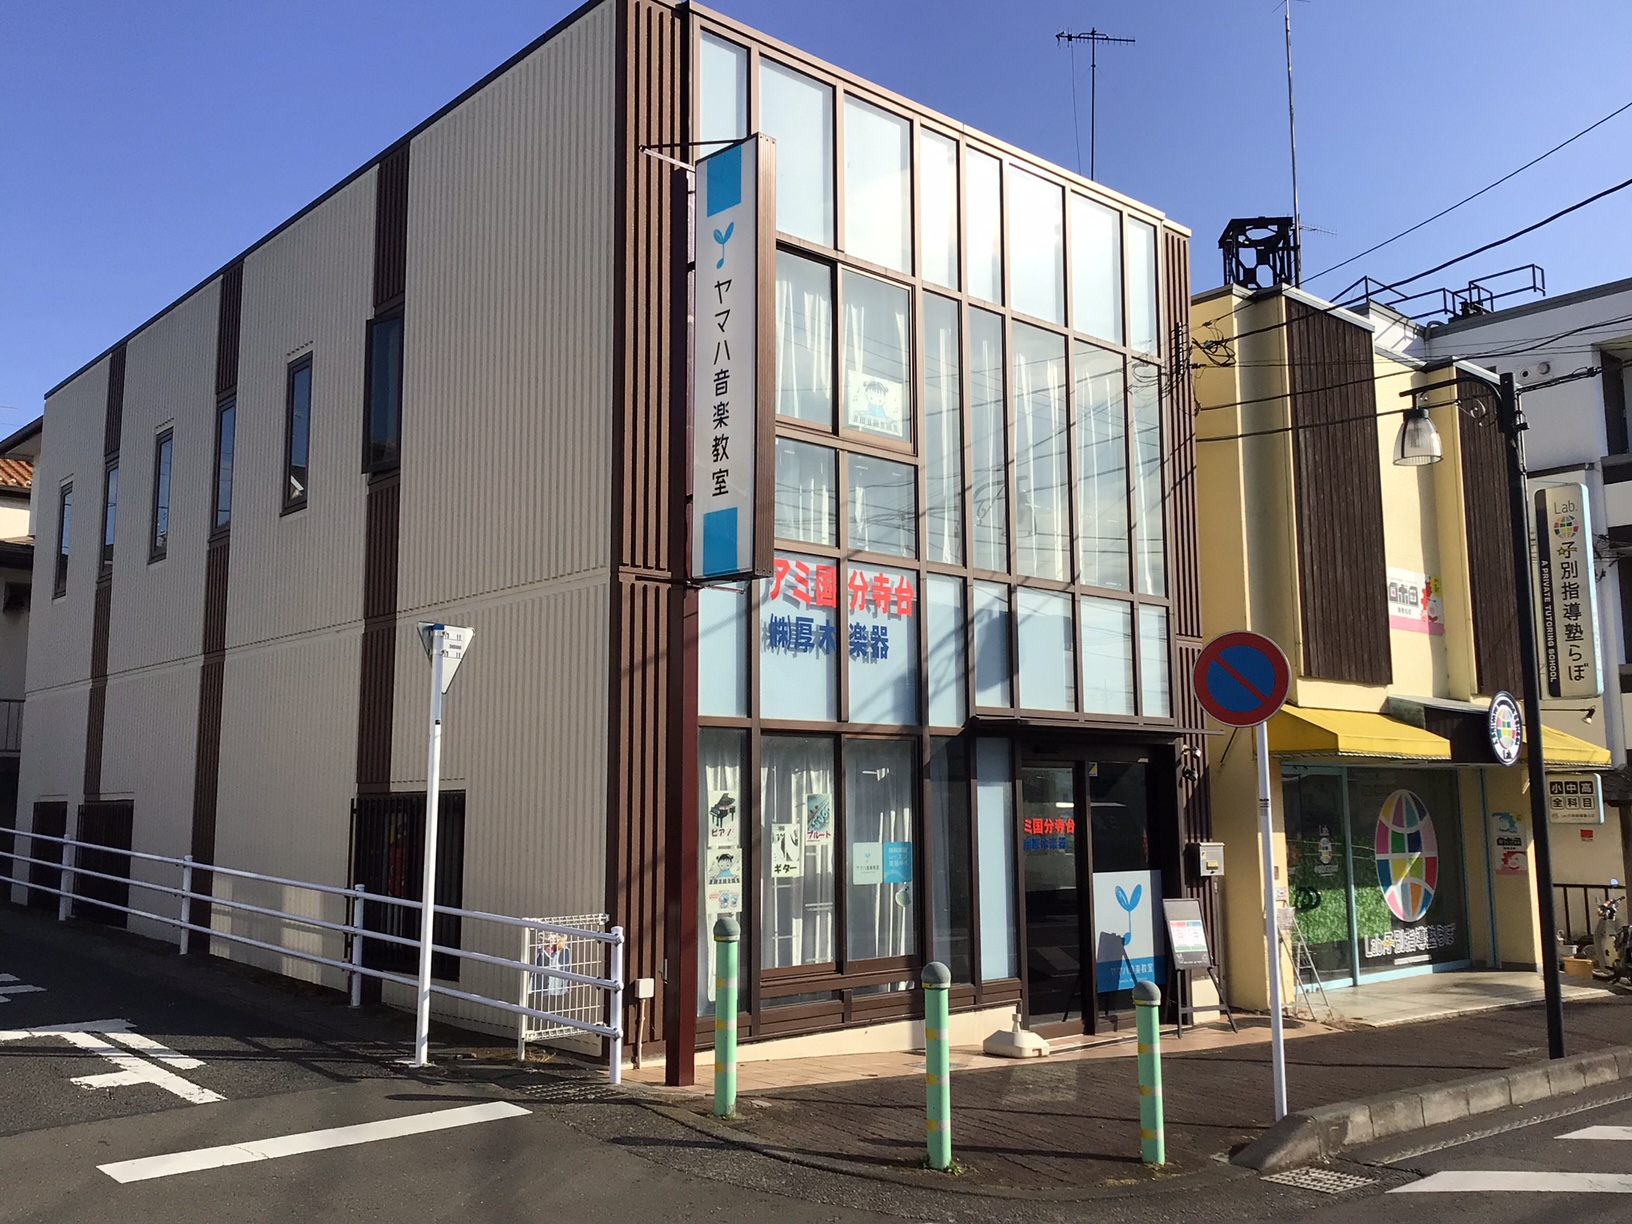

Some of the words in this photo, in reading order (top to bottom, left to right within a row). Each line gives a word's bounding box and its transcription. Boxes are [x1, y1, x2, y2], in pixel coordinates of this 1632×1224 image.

[712, 279, 732, 497] ヤマハ音楽教室
[1554, 501, 1578, 514] Lab.
[1542, 567, 1551, 602] PRIVATE
[1545, 604, 1555, 647] TUTORING
[1548, 648, 1558, 682] SCHOOL
[1551, 783, 1592, 793] 小中高
[1552, 797, 1592, 808] 全科目
[711, 828, 732, 837] ピアノ
[807, 830, 831, 839] フルート
[774, 864, 797, 873] ギター
